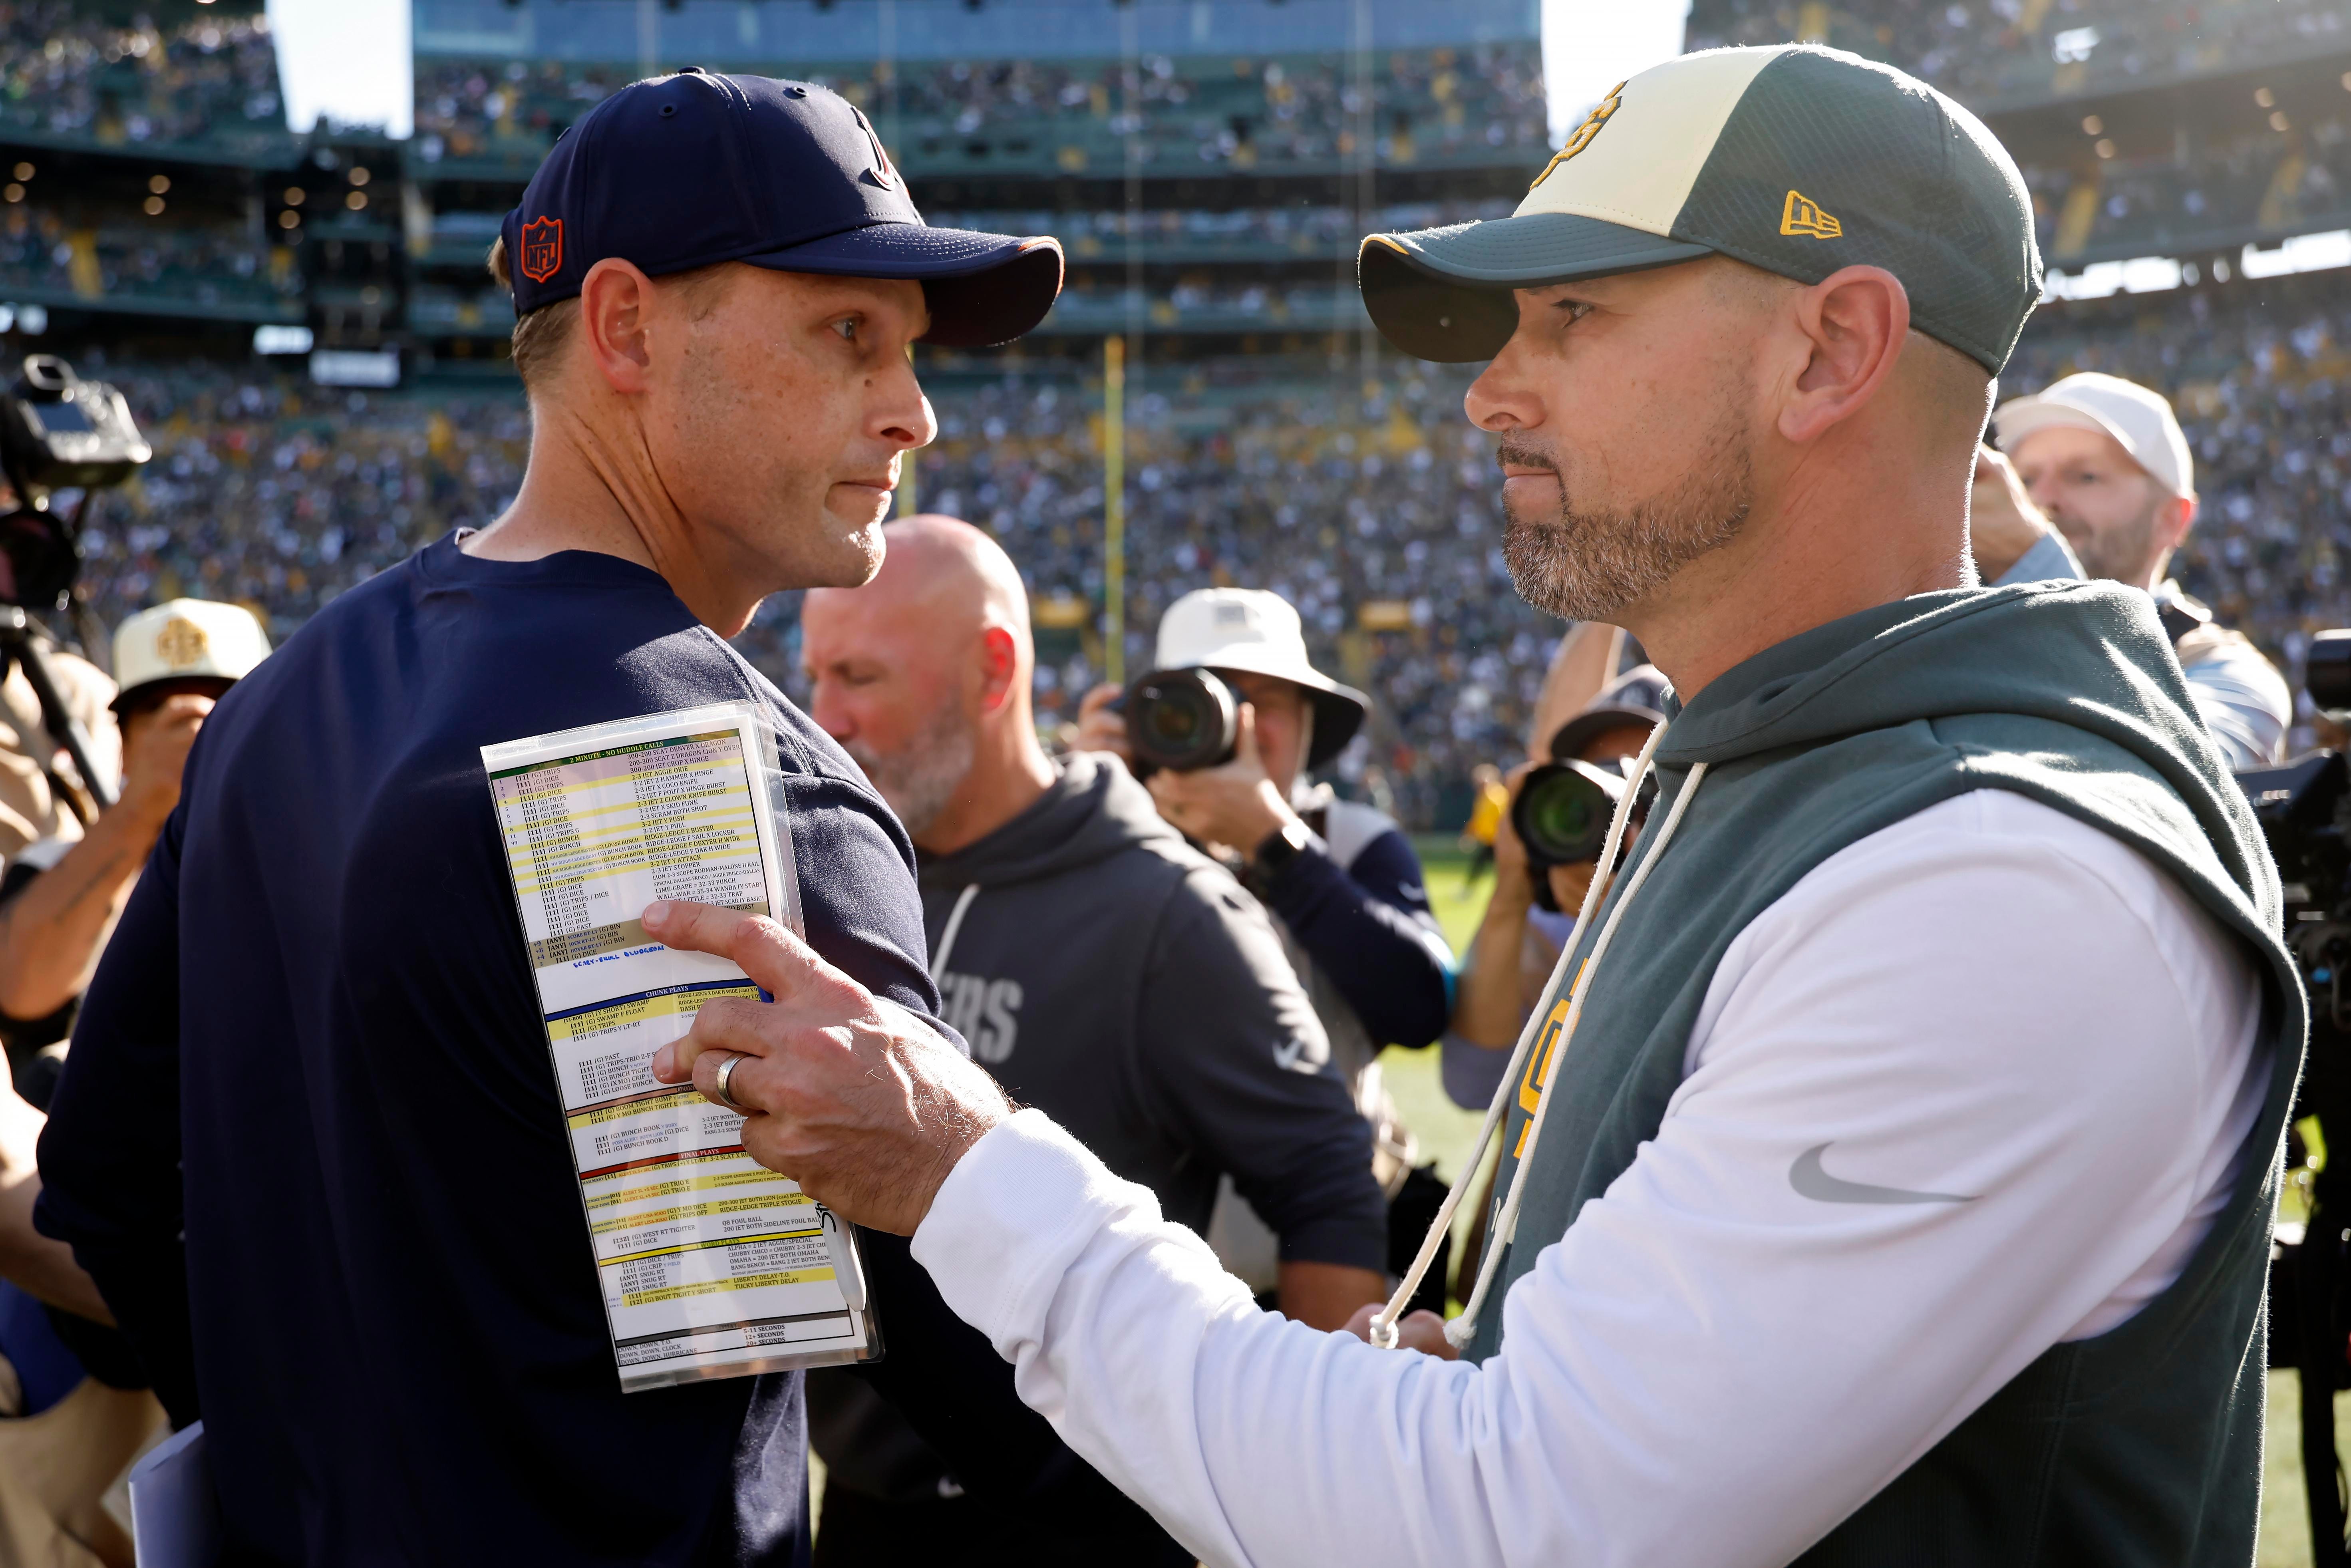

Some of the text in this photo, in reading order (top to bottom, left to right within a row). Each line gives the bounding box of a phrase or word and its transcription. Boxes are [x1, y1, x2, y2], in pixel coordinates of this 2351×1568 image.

[528, 245, 554, 270] NFL
[575, 752, 601, 762] MINUTE
[617, 744, 643, 754] HUDDLE
[644, 741, 664, 749] CALLS
[627, 751, 652, 759] 300-200
[629, 757, 653, 766] 200-300
[676, 750, 701, 758] DRAGON
[630, 764, 654, 773] 300-200
[660, 773, 688, 782] HAMMER
[644, 829, 685, 840] RIDGE-LEDGE
[646, 836, 686, 847] RIDGE-LEDGE
[694, 864, 741, 873] RODMAN-MALONE
[656, 883, 692, 893] LIME-GRAPE
[657, 890, 691, 900] WALL-WAR
[547, 936, 564, 945] [ANY]
[646, 988, 668, 997] CHUNK
[596, 1013, 619, 1022] SWAMP
[626, 1007, 644, 1016] FLOAT
[612, 1084, 631, 1092] LOOSE
[632, 1079, 653, 1088] BUNCH
[720, 1204, 758, 1212] RIDGE-LEDGE
